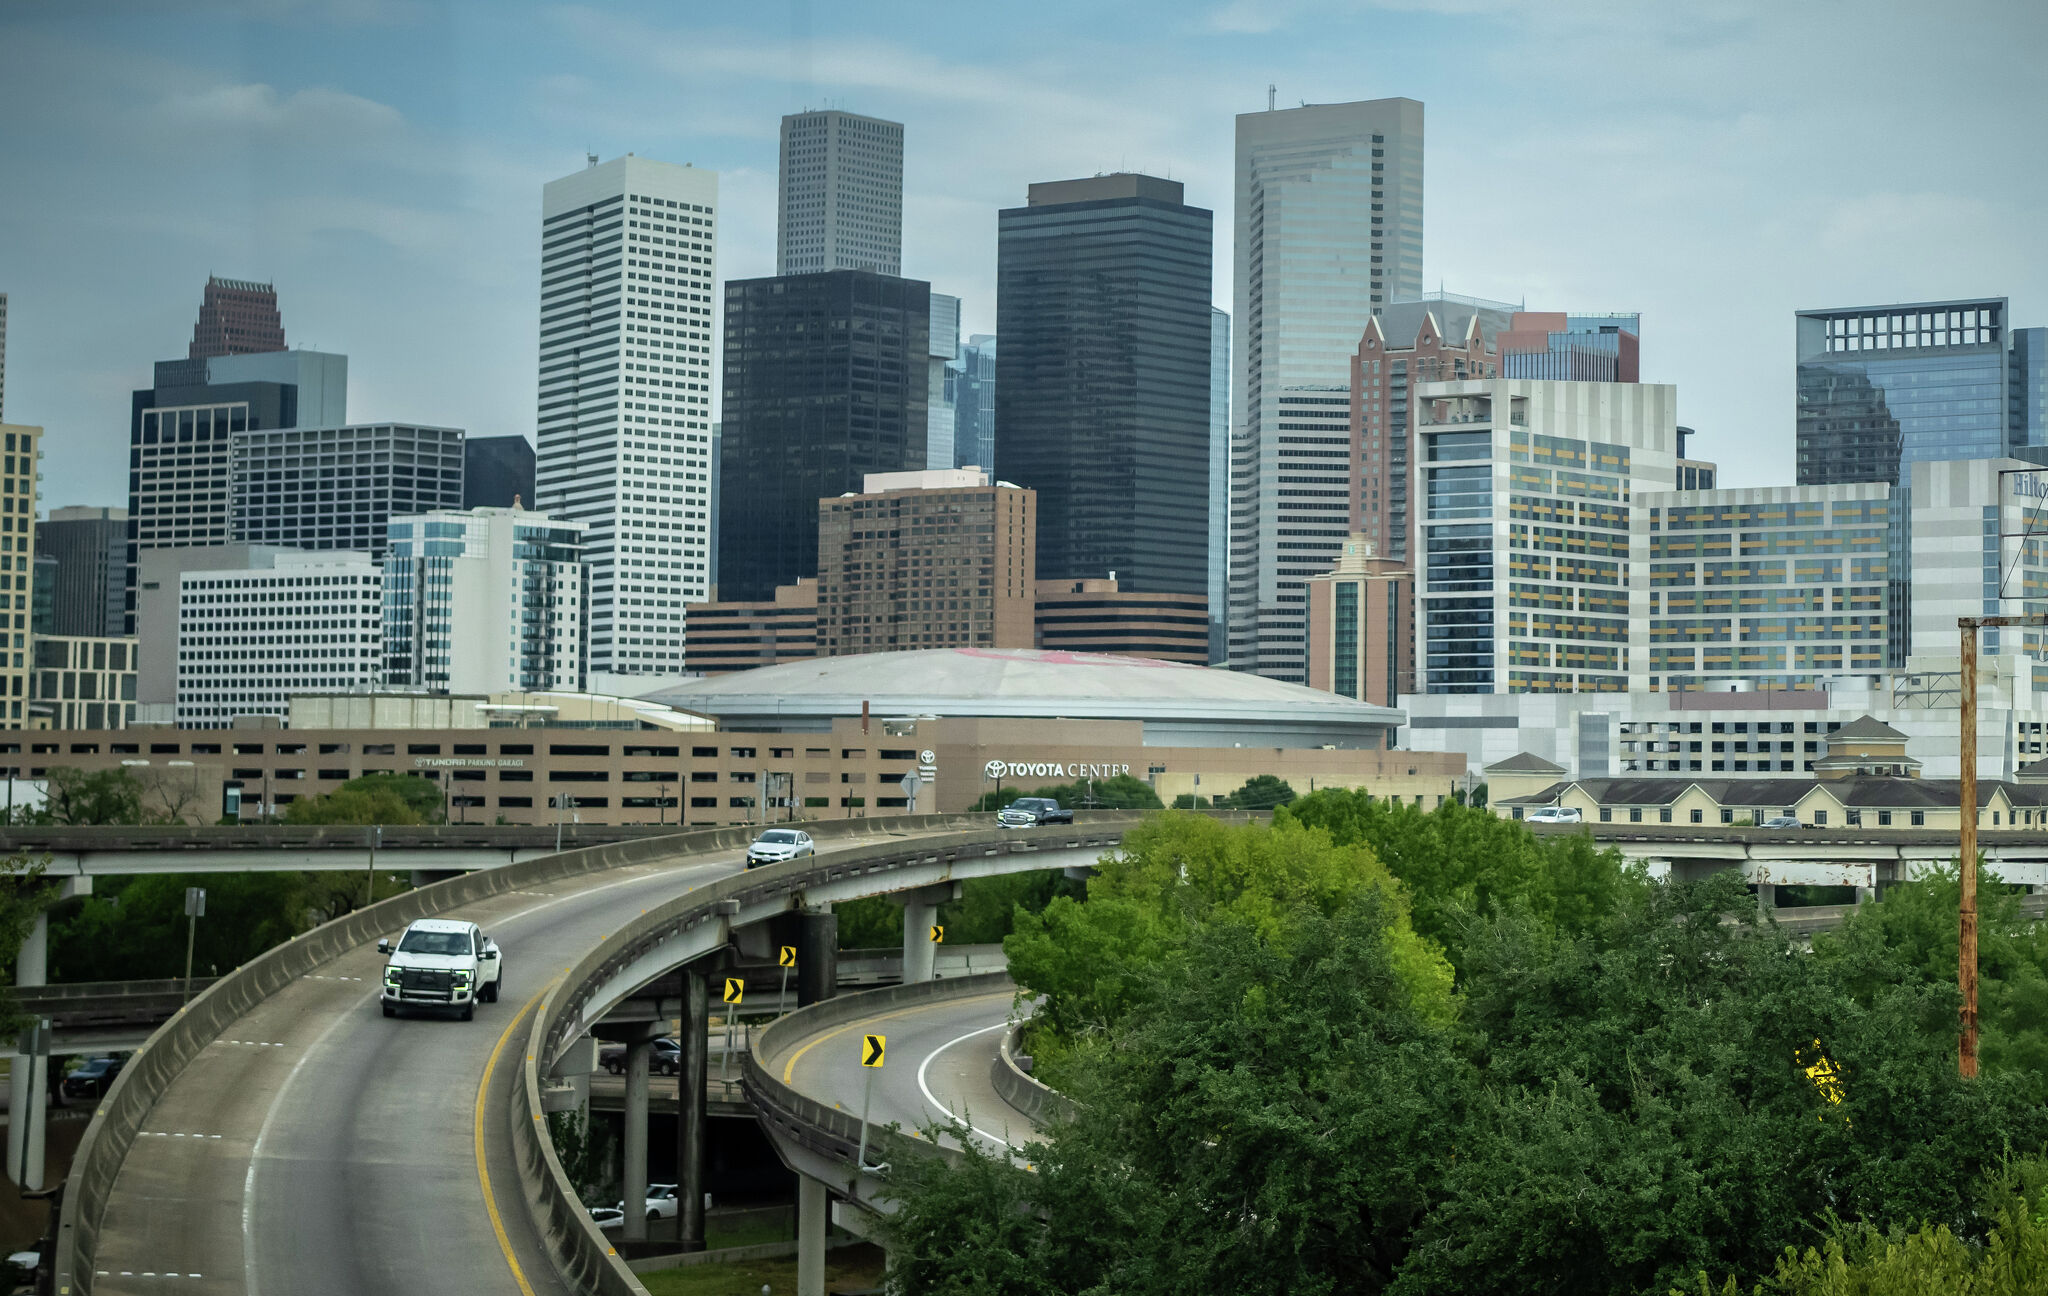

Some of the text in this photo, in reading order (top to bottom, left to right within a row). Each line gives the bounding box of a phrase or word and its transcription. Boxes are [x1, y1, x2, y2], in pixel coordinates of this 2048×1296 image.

[2013, 472, 2048, 499] Hilto
[424, 758, 466, 766] TUNDRA
[467, 758, 496, 767] PARKING
[1007, 763, 1130, 777] TOYOTA CENTER
